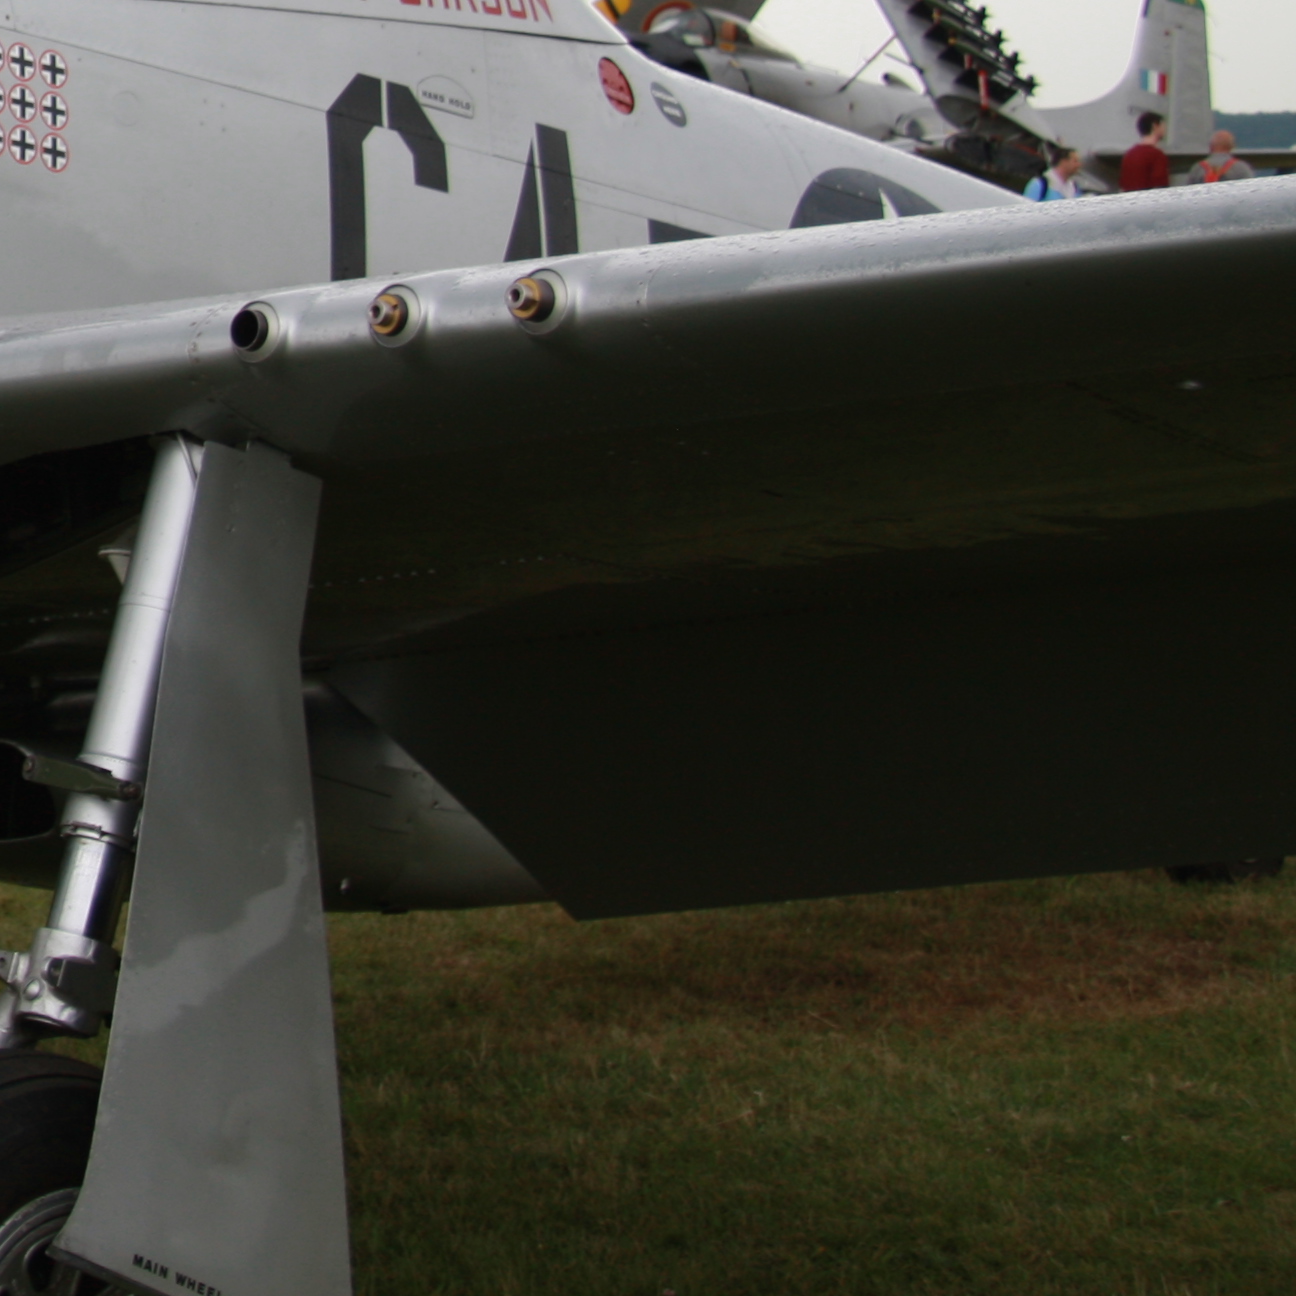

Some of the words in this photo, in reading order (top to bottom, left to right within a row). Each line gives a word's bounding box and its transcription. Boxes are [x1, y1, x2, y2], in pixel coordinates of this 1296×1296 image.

[421, 90, 445, 103] HAND
[448, 98, 472, 111] HOLD
[132, 1254, 168, 1279] MAIN
